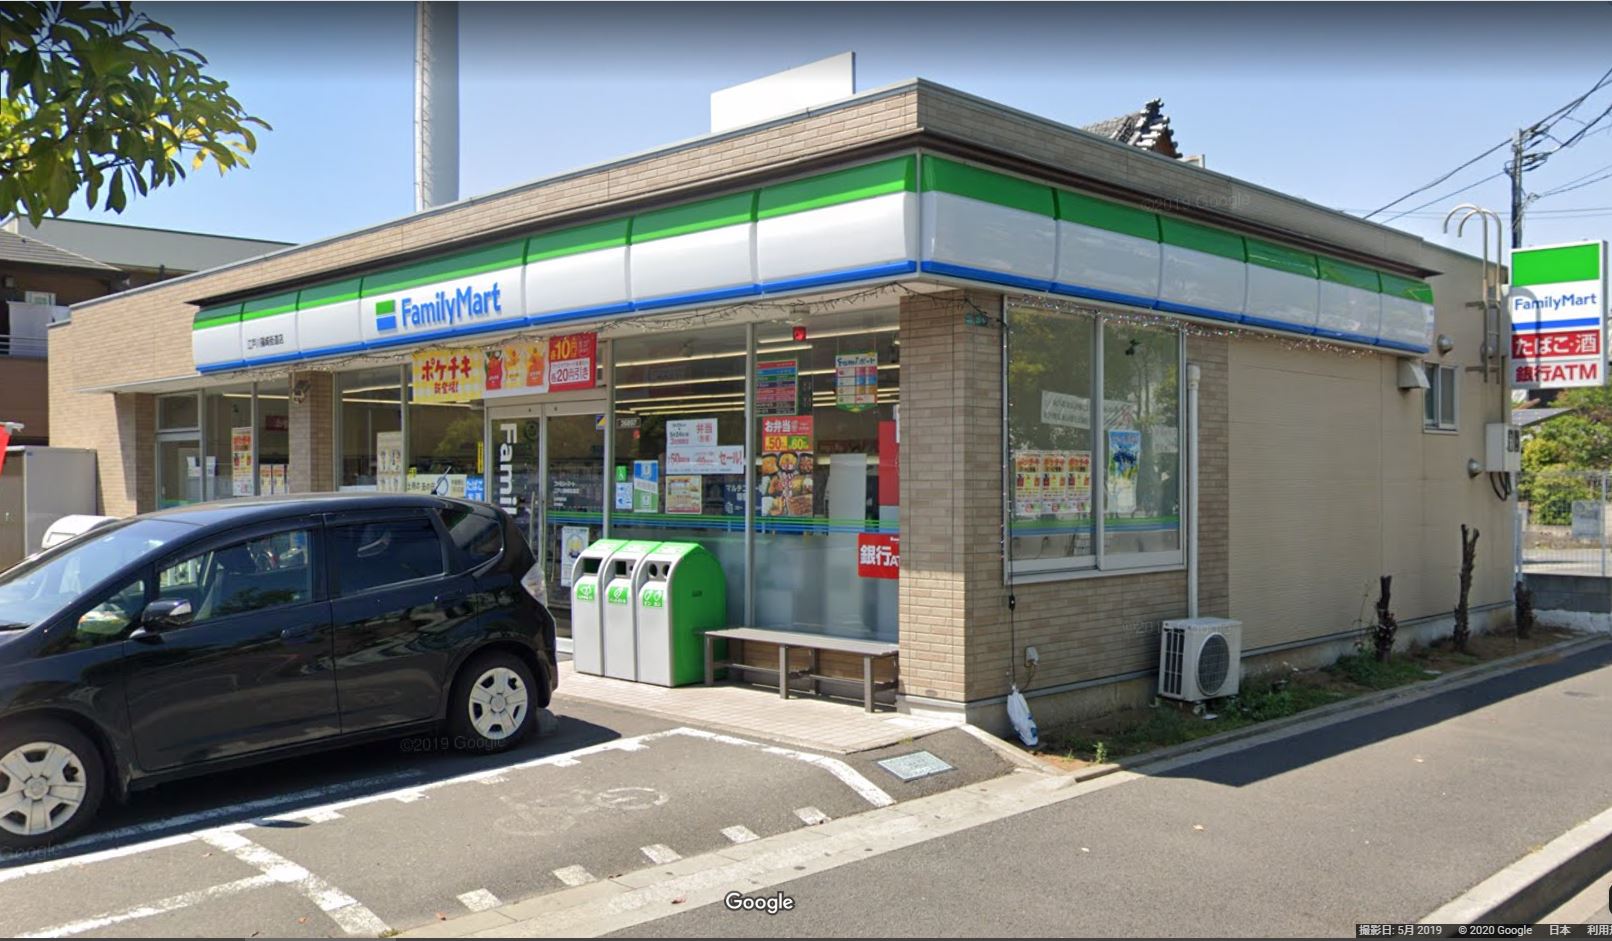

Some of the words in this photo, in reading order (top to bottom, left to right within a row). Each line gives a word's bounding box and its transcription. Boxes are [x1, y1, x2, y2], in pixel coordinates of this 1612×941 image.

[401, 282, 502, 328] FamilyMart
[1514, 294, 1597, 311] FamilyMart
[421, 355, 472, 382] ポケチキ
[1515, 363, 1597, 383] 銀行ATM
[860, 544, 899, 567] 銀行A
